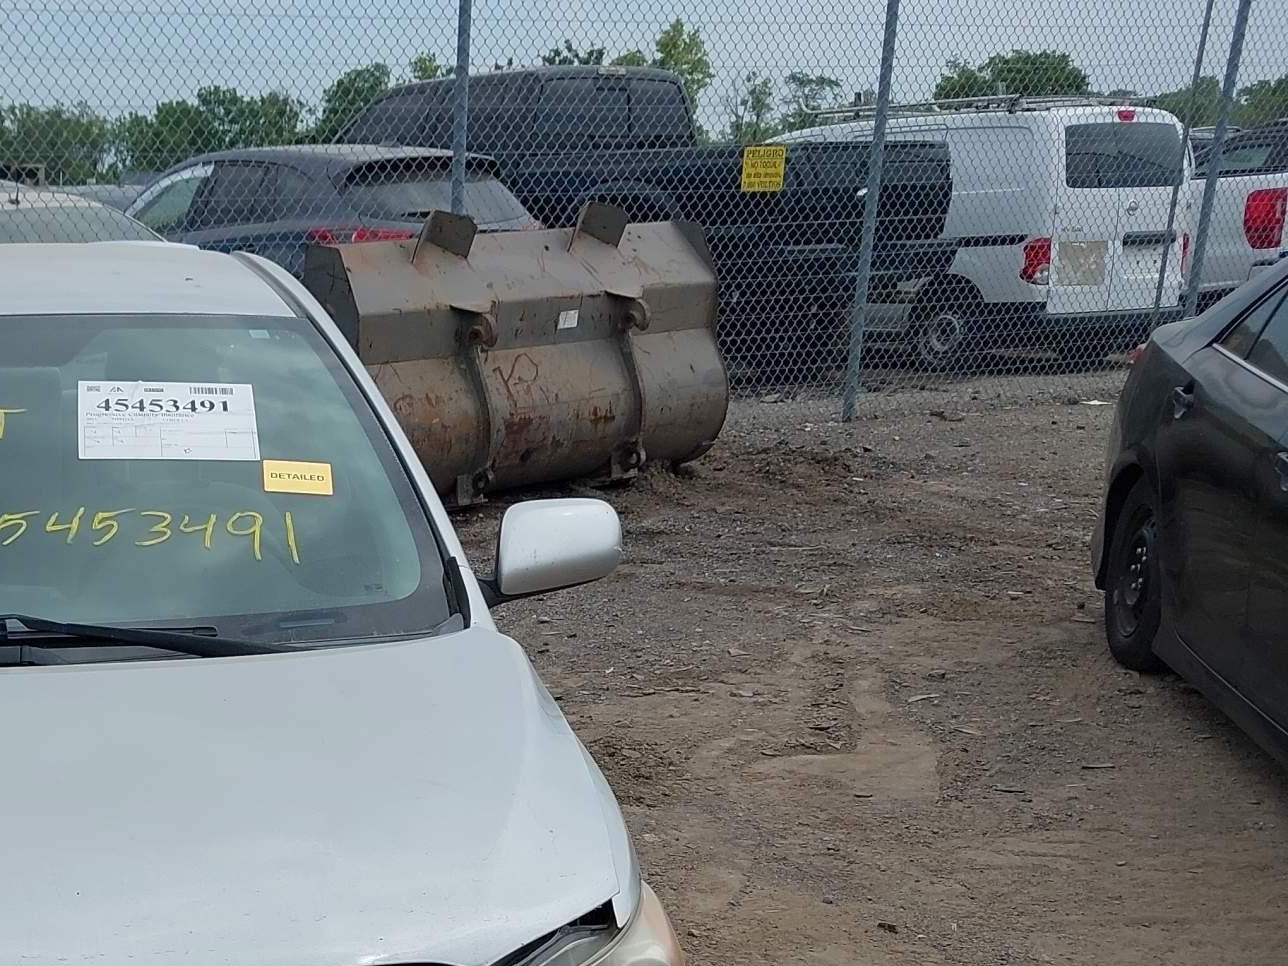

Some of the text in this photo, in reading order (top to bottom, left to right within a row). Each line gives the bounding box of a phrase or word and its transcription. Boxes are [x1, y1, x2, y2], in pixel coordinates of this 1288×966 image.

[746, 148, 784, 158] PELIGRO
[96, 398, 229, 413] 45453491
[270, 472, 325, 482] DETAILED
